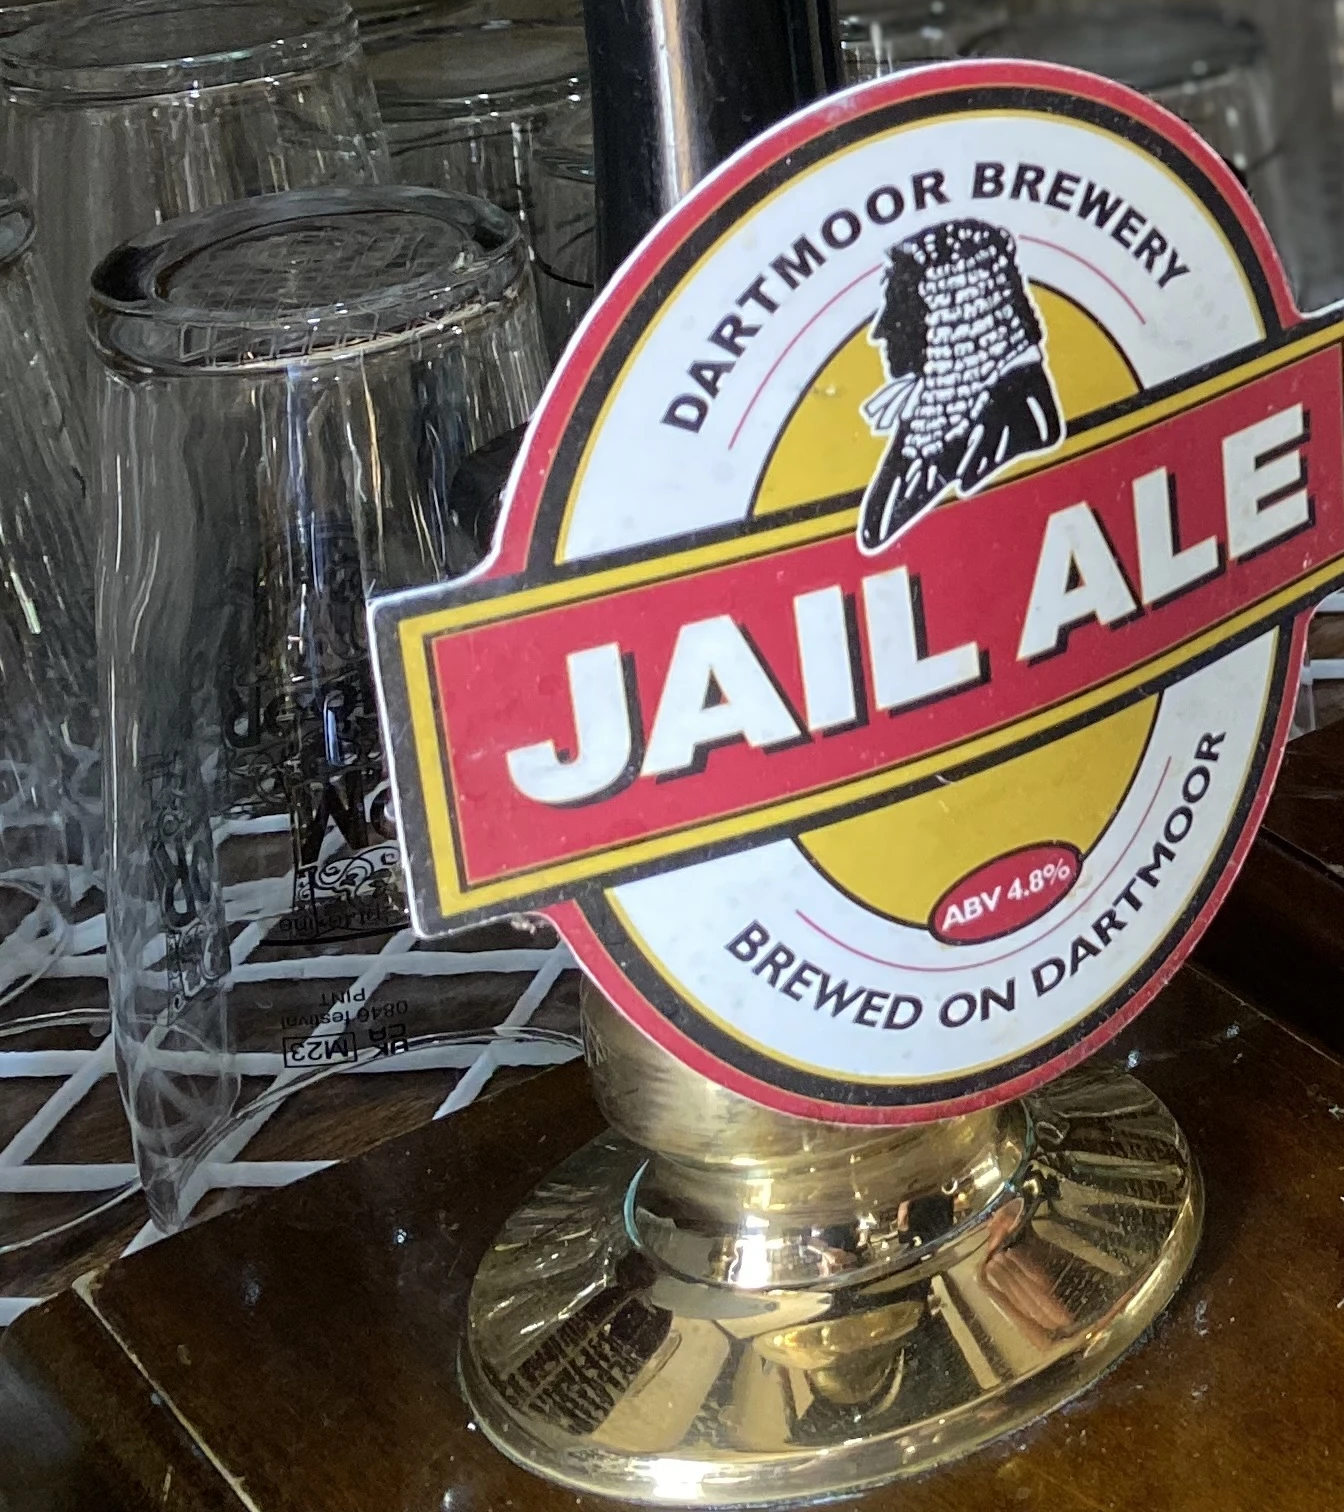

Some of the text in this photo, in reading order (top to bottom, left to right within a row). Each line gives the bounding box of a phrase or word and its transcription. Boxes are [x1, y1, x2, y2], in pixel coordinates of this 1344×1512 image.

[660, 161, 1191, 434] DARTMOOR BREWERY
[505, 403, 1311, 808] JAIL ALE
[724, 730, 1227, 1031] BREWED ON DARTMOOR
[941, 857, 1071, 931] ABV 4.8%
[291, 1038, 349, 1062] M23
[319, 988, 366, 1007] PINT
